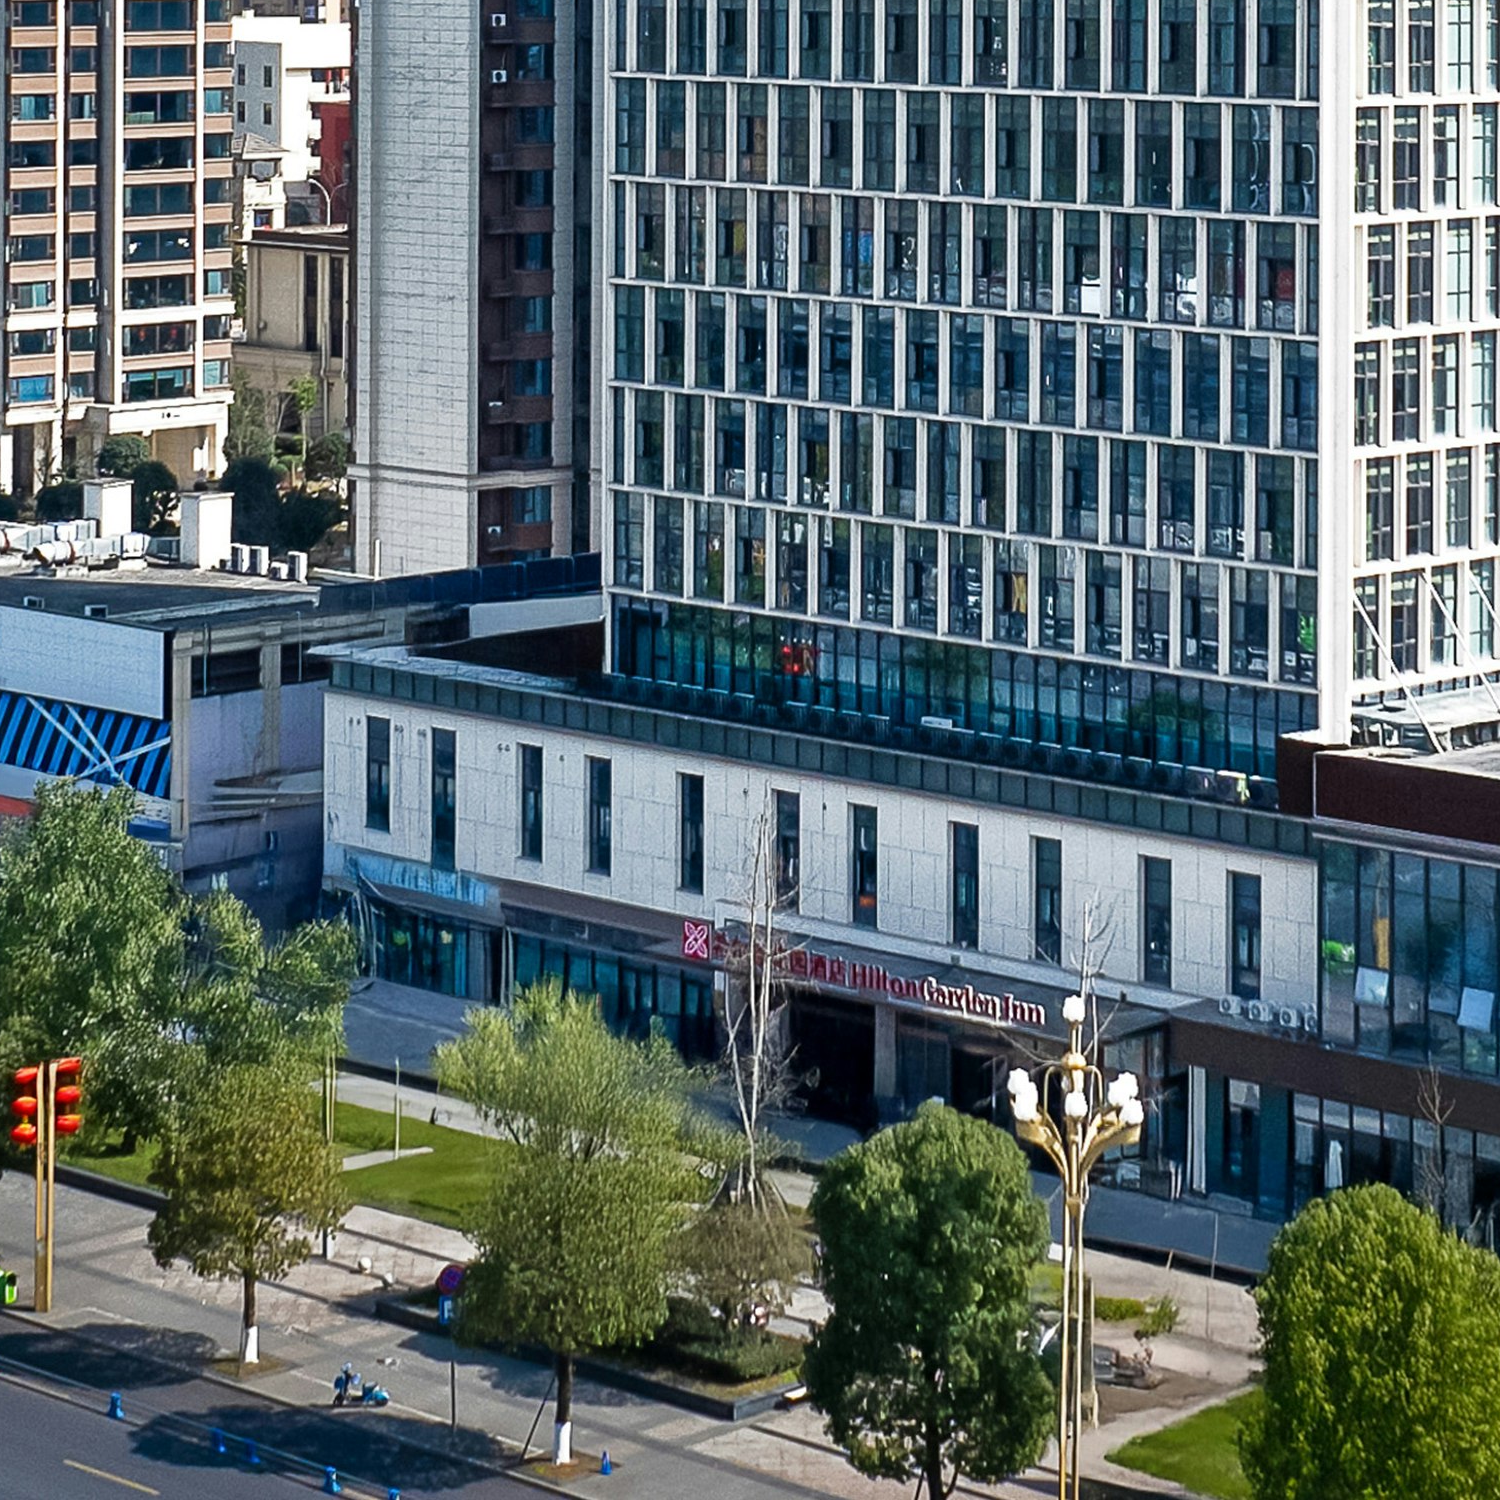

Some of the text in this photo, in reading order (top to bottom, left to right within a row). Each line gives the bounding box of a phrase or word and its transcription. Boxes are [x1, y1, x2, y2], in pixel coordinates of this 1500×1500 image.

[850, 961, 922, 998] Hilton
[921, 976, 1000, 1019] Garden
[1003, 992, 1046, 1026] Inn
